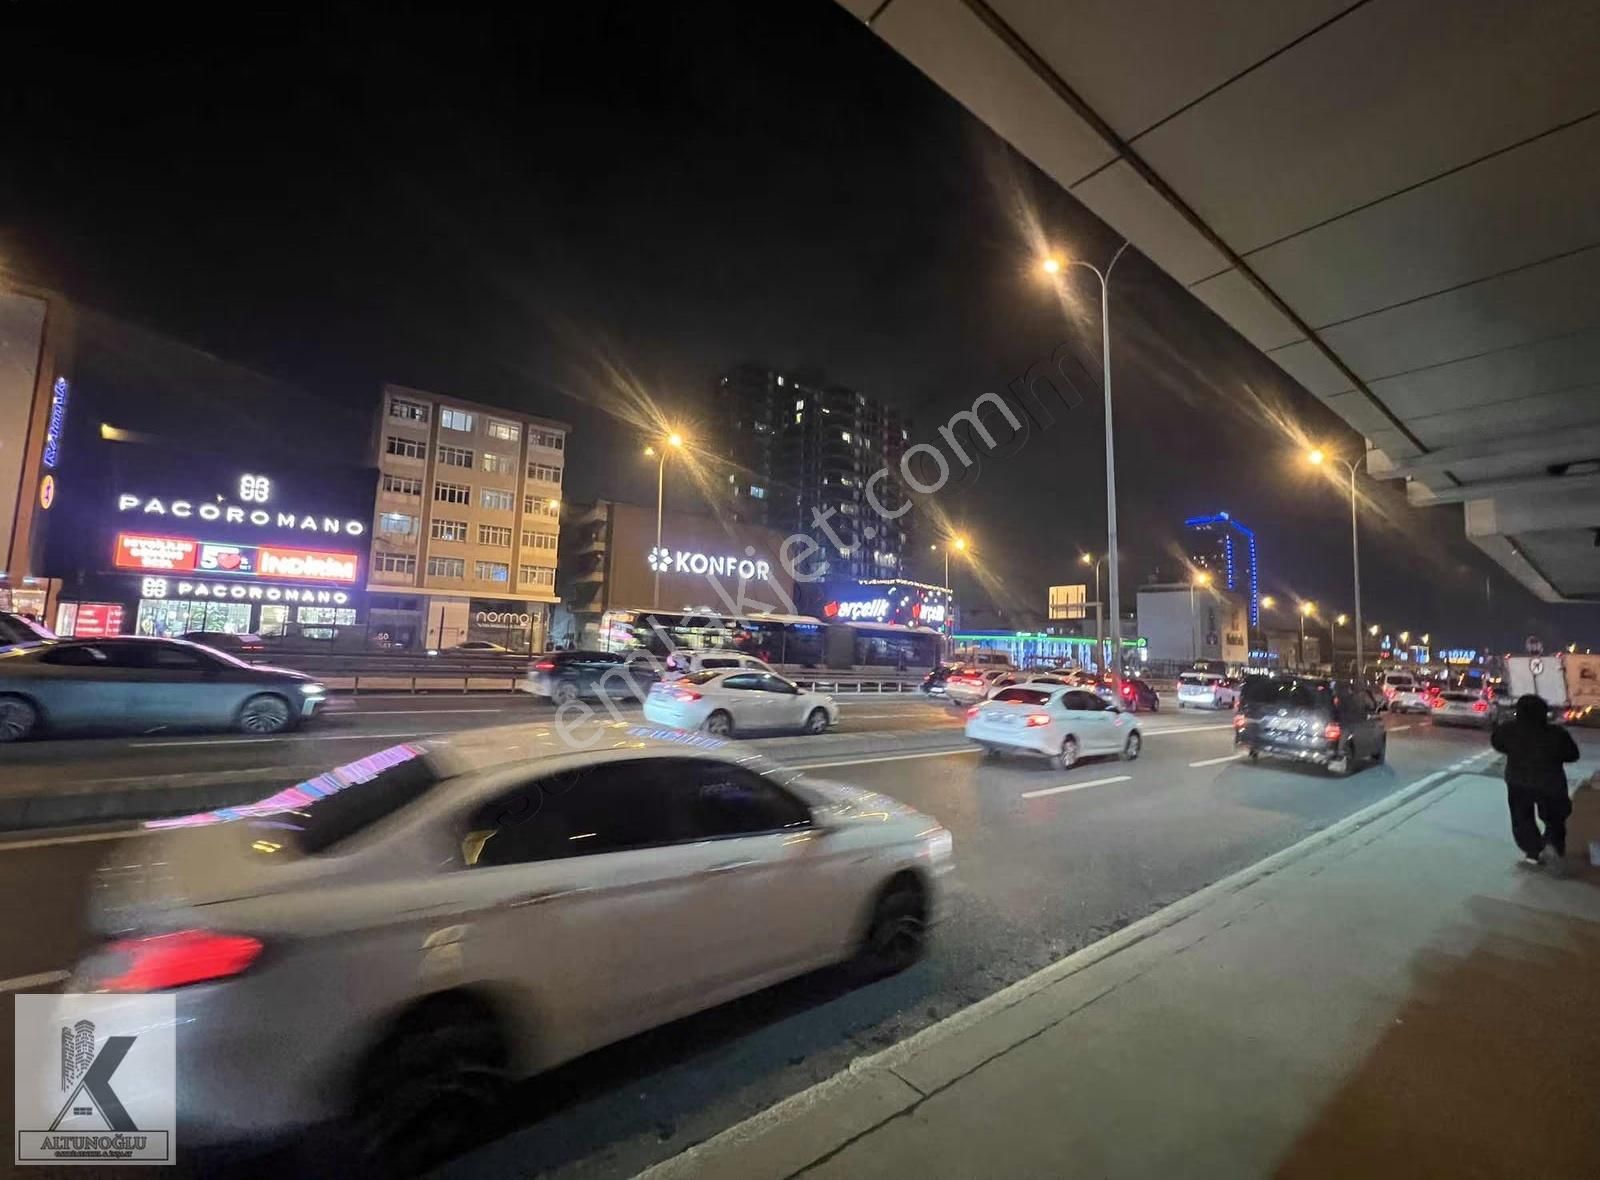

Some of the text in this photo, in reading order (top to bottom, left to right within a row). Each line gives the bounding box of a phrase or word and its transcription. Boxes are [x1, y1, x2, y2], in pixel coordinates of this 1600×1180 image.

[119, 495, 364, 535] PACOROMANO
[676, 551, 769, 580] KONFOR
[178, 582, 348, 604] PACOROMANO
